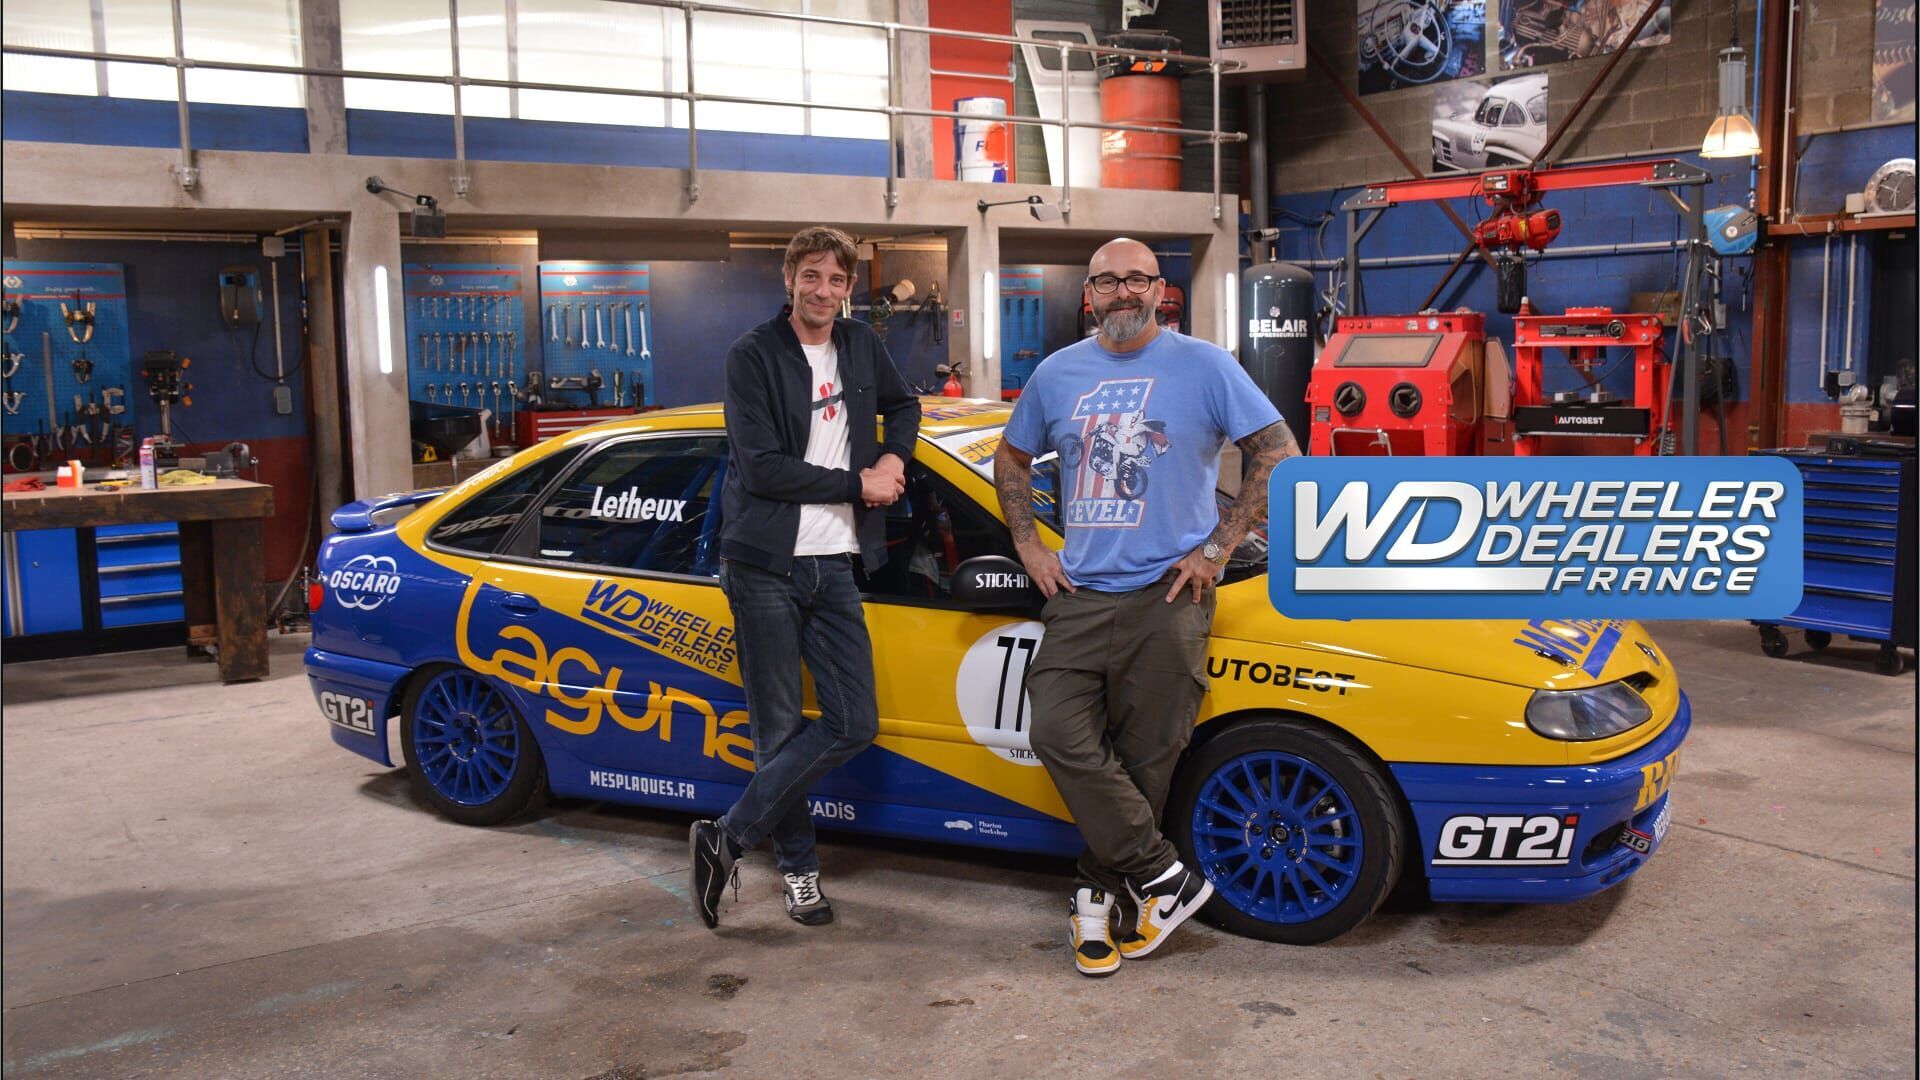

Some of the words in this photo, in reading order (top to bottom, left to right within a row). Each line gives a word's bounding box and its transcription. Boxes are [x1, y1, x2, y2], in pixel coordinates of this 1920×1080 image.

[1249, 319, 1308, 332] BELAIR
[1559, 416, 1605, 425] AUTOBEST
[590, 486, 687, 522] Letheux
[1074, 500, 1127, 522] EVEL
[330, 570, 401, 595] OSCARO
[586, 579, 650, 622] WD
[638, 615, 736, 664] DEALERS
[660, 640, 729, 674] FRANCE
[320, 691, 374, 731] GT2i
[589, 770, 696, 800] MESPLAQUES.FR
[979, 827, 1008, 838] Workshop
[1438, 815, 1578, 858] GT2i
